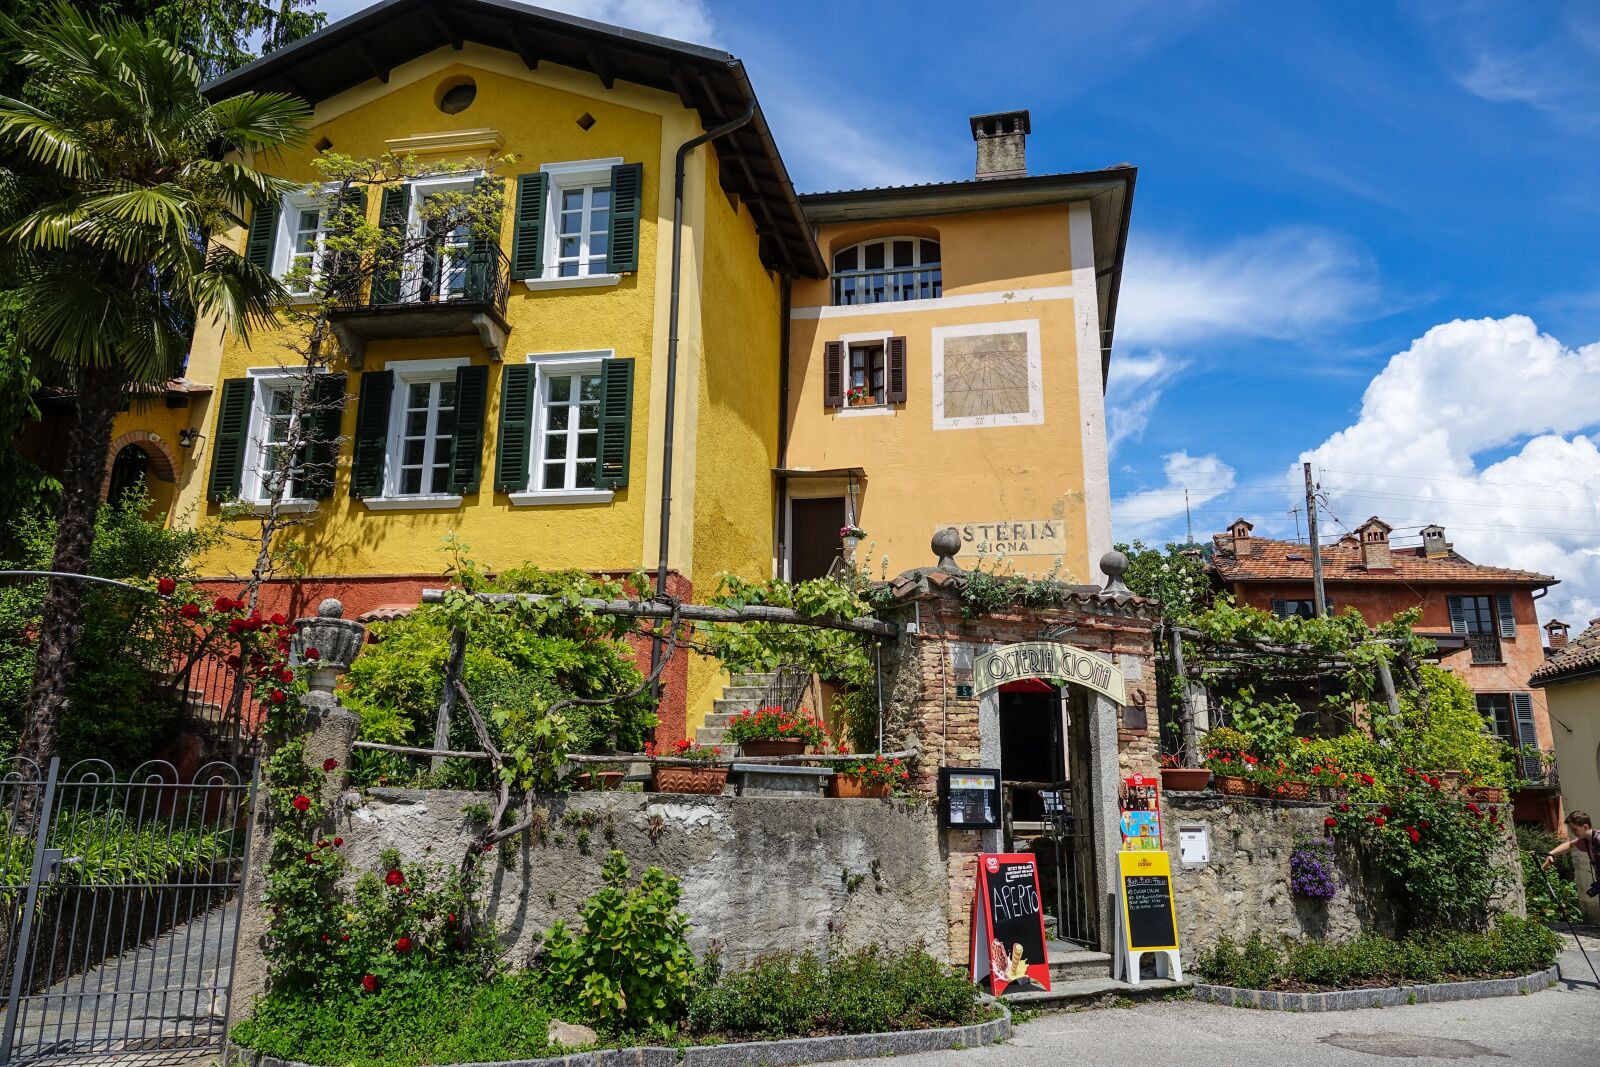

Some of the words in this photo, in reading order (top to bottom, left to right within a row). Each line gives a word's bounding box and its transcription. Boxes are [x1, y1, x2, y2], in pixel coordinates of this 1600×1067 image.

[948, 522, 1057, 542] STERIA
[987, 649, 1054, 680] OSTERIA
[1060, 652, 1112, 690] CIONA
[962, 687, 967, 696] 5
[993, 884, 1040, 923] APERTO
